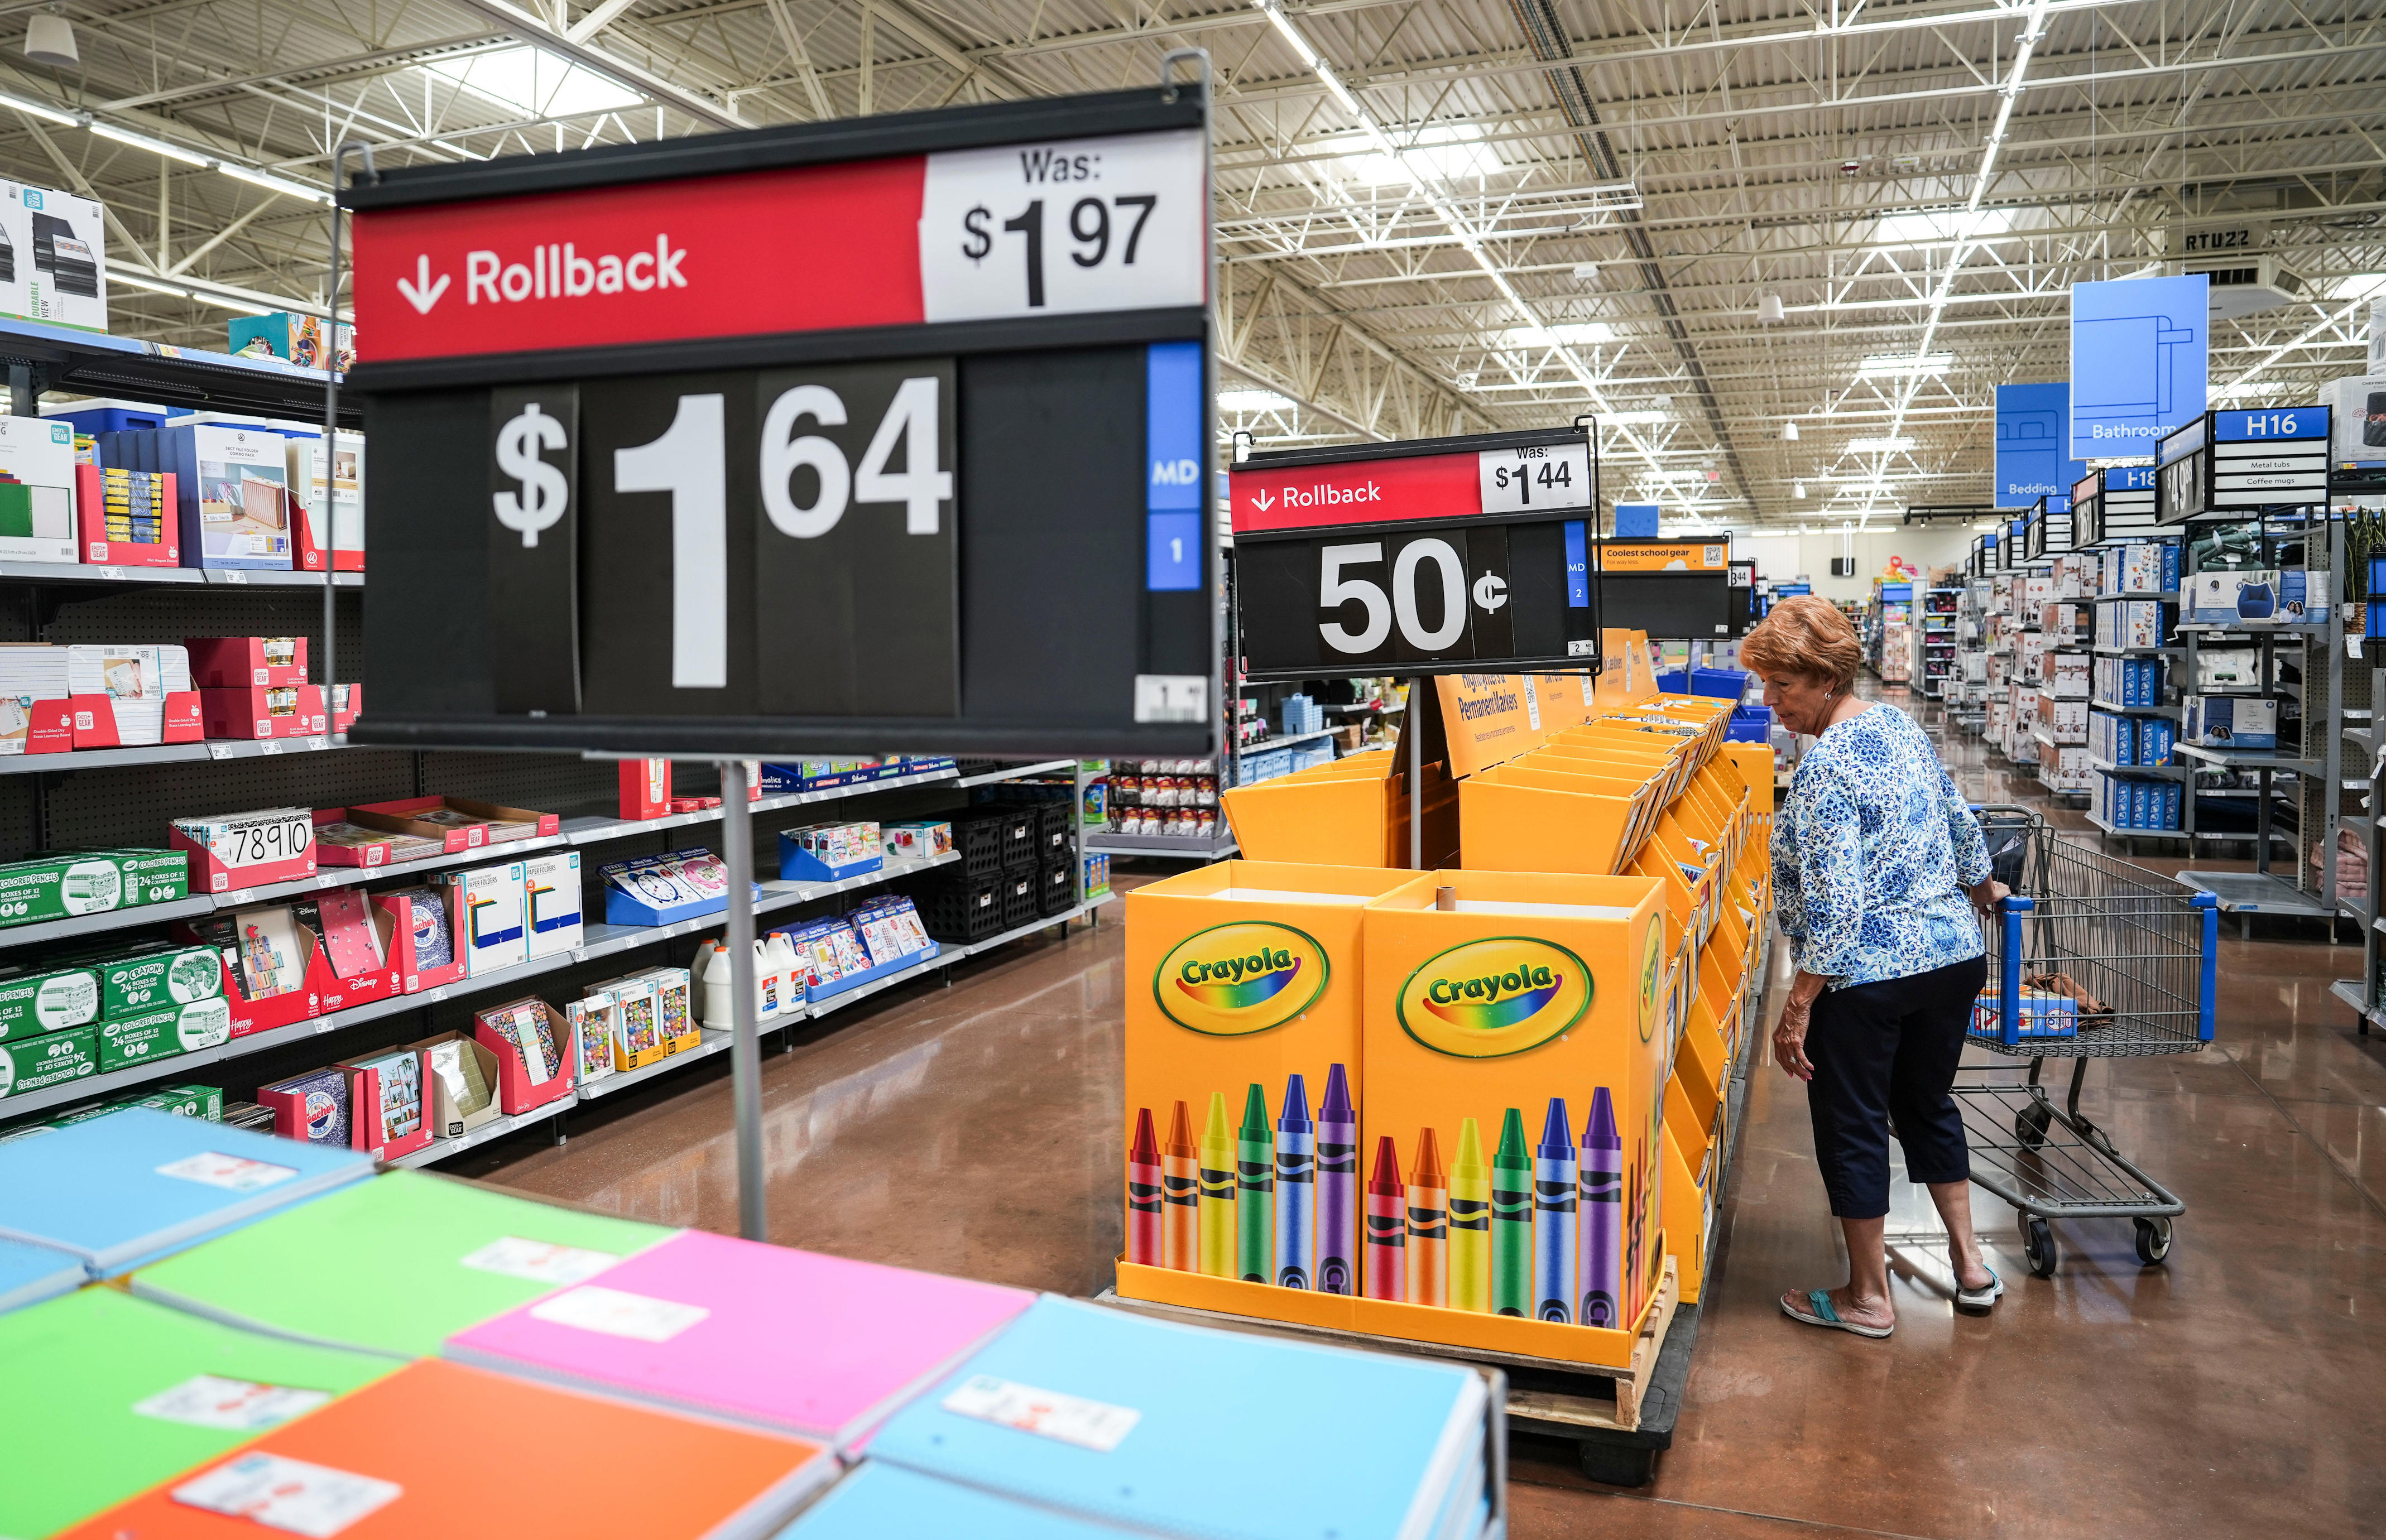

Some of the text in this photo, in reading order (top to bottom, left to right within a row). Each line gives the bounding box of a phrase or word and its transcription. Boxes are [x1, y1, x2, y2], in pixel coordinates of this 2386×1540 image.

[1020, 150, 1103, 184] Was:
[2186, 230, 2249, 251] RTU22
[466, 234, 689, 305] Rollback
[31, 281, 40, 316] DURABLE
[296, 367, 307, 376] for
[2093, 423, 2177, 439] Bathroom
[2247, 413, 2298, 436] H16
[54, 433, 68, 441] GEAR
[1516, 446, 1549, 459] Was:
[1151, 458, 1201, 485] MD
[1283, 480, 1381, 508] Rollback
[2009, 483, 2057, 495] Bedding
[1169, 537, 1183, 563] 1
[1640, 548, 1669, 557] school
[1568, 562, 1585, 572] MD
[1576, 589, 1582, 598] 2
[1575, 644, 1580, 652] 2
[1458, 689, 1518, 721] Permanent Markers
[233, 822, 306, 863] 7 8 9 10
[139, 856, 186, 869] COLORED PENCILS
[369, 854, 382, 862] GEAR
[540, 865, 556, 874] FOLDERS
[0, 872, 59, 888] COLORED PENCILS
[139, 875, 151, 886] 24
[215, 880, 227, 888] GEAR
[481, 877, 497, 886] FOLDERS
[1, 889, 22, 898] BOXES
[129, 963, 165, 980] CRAYONS
[1180, 946, 1292, 989] Crayola
[120, 982, 132, 993] 24
[132, 978, 150, 986] BOXES
[1428, 964, 1554, 1007] Crayola
[5, 987, 35, 1002] PENCILS
[323, 994, 344, 1007] Happy
[122, 1012, 176, 1032] COLORED PENCILS
[231, 1018, 254, 1032] Happy
[112, 1035, 124, 1048] 24
[124, 1031, 143, 1040] BOXES
[36, 1058, 53, 1066] PENCILS
[73, 1051, 87, 1063] 24
[17, 1067, 76, 1090] COLORED PENCILS
[313, 1125, 327, 1134] ERA
